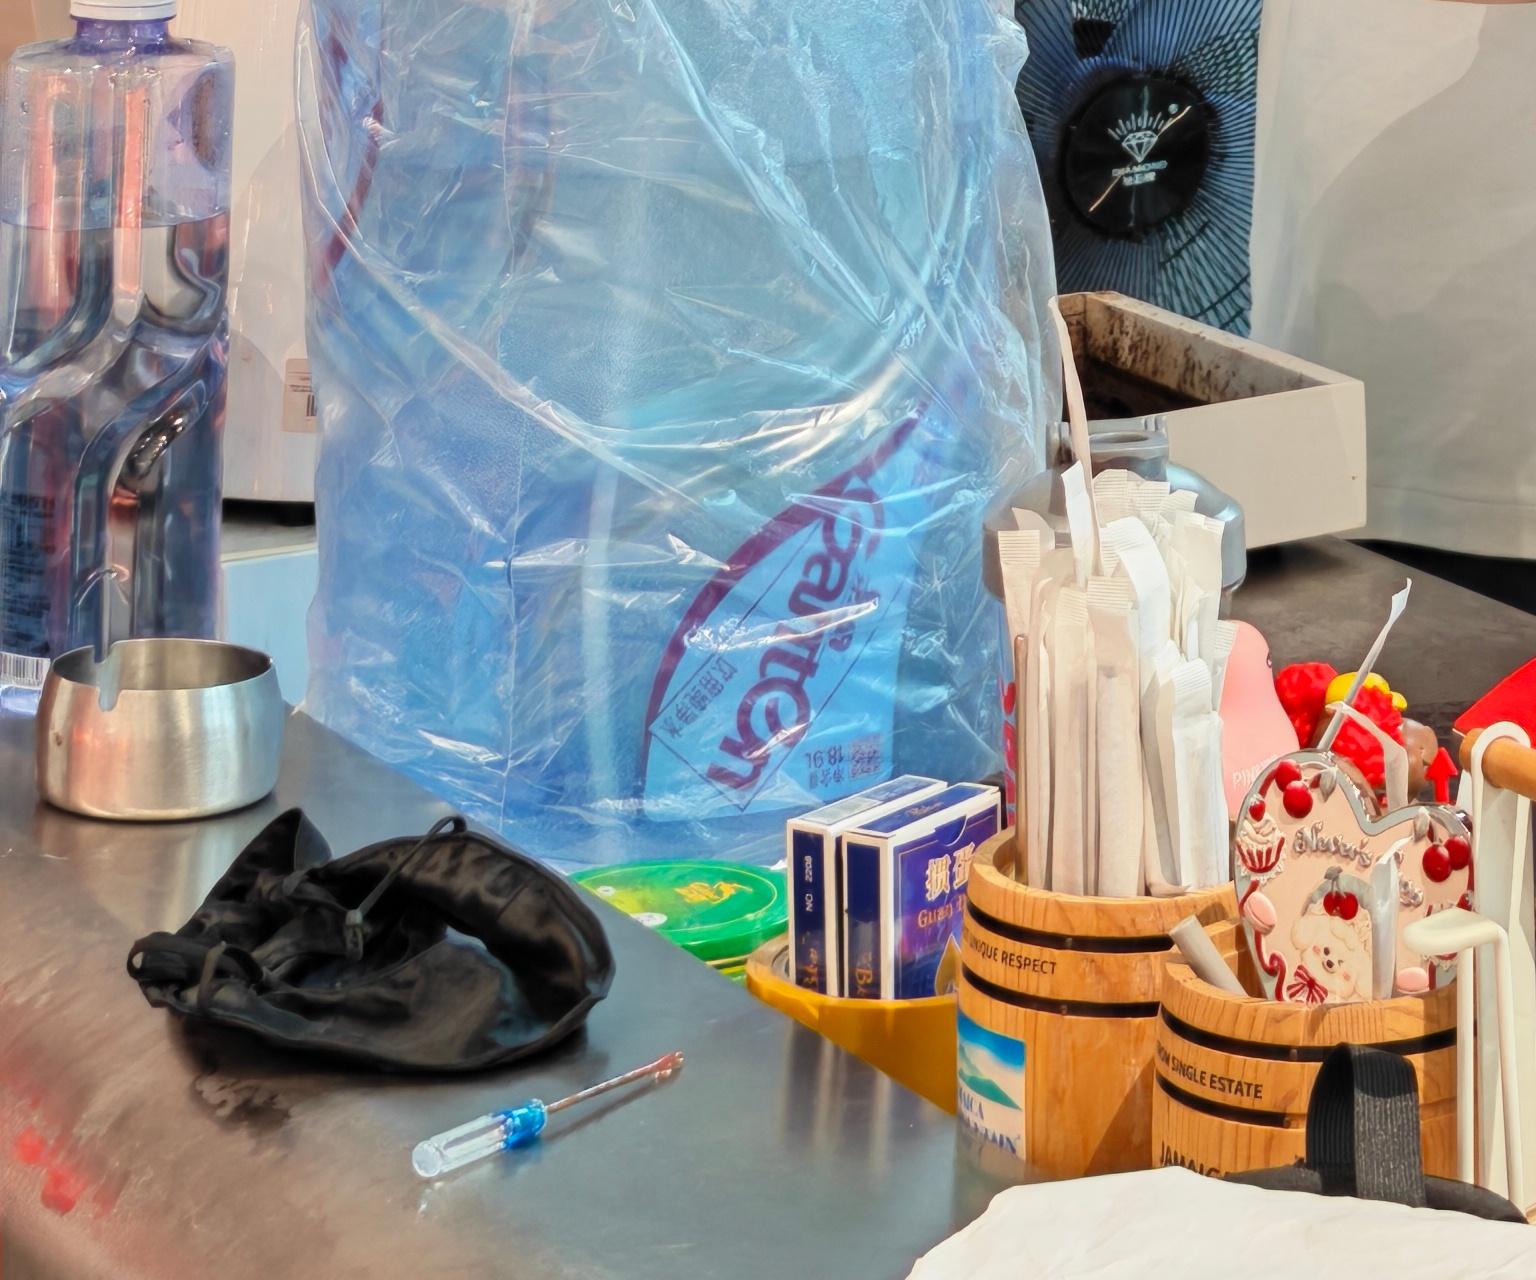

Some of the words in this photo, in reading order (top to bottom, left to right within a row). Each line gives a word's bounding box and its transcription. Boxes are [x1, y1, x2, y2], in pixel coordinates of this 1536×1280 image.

[1001, 950, 1057, 976] RESPECT
[1172, 1055, 1207, 1087] SINGLE
[1209, 1073, 1264, 1100] ESTATE
